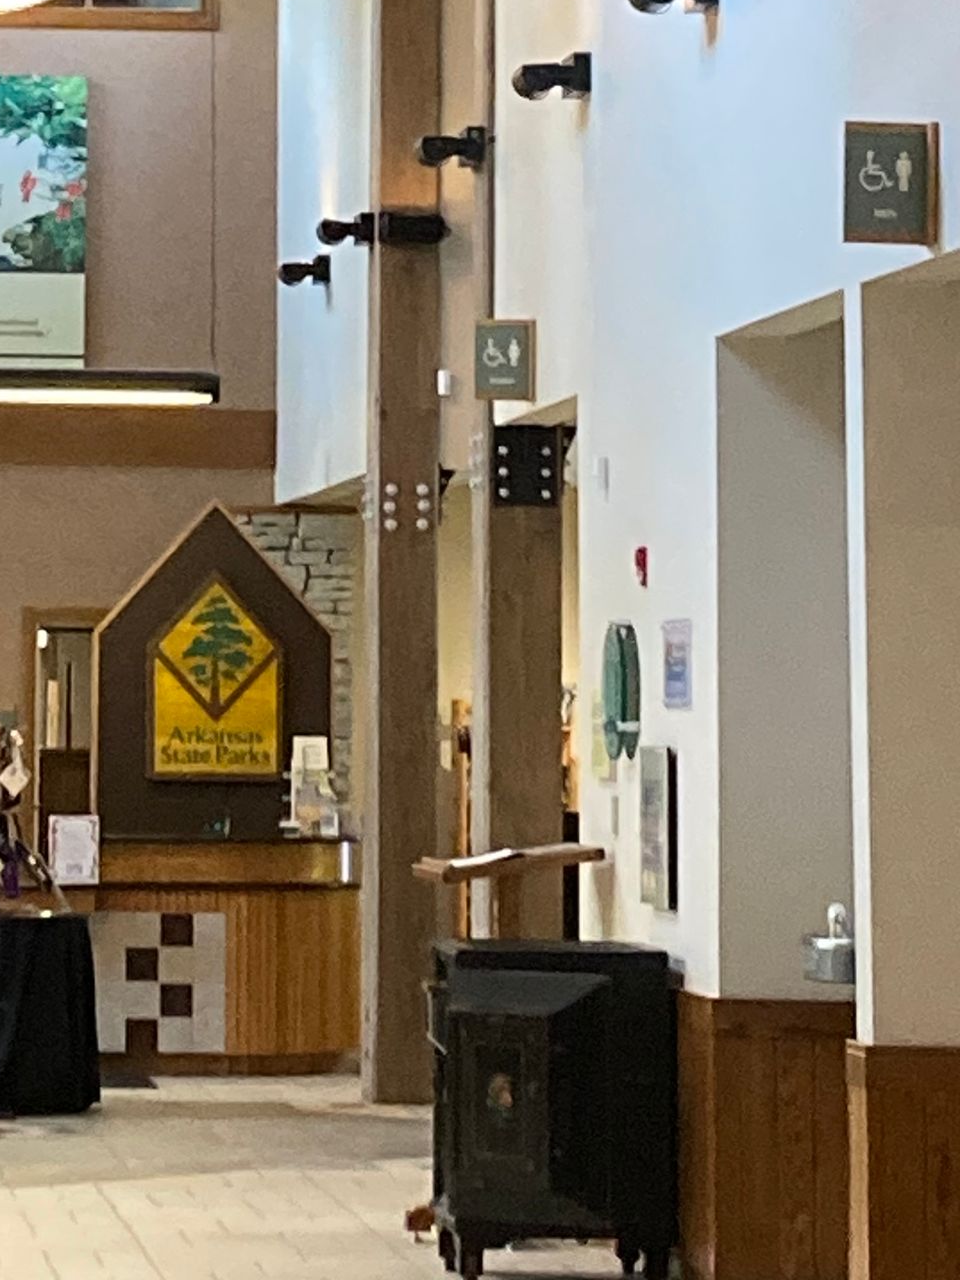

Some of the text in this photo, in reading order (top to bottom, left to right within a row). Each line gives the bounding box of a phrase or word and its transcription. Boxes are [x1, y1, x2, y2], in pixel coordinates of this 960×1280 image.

[168, 725, 263, 745] Arkansas
[160, 744, 272, 766] State Parks
